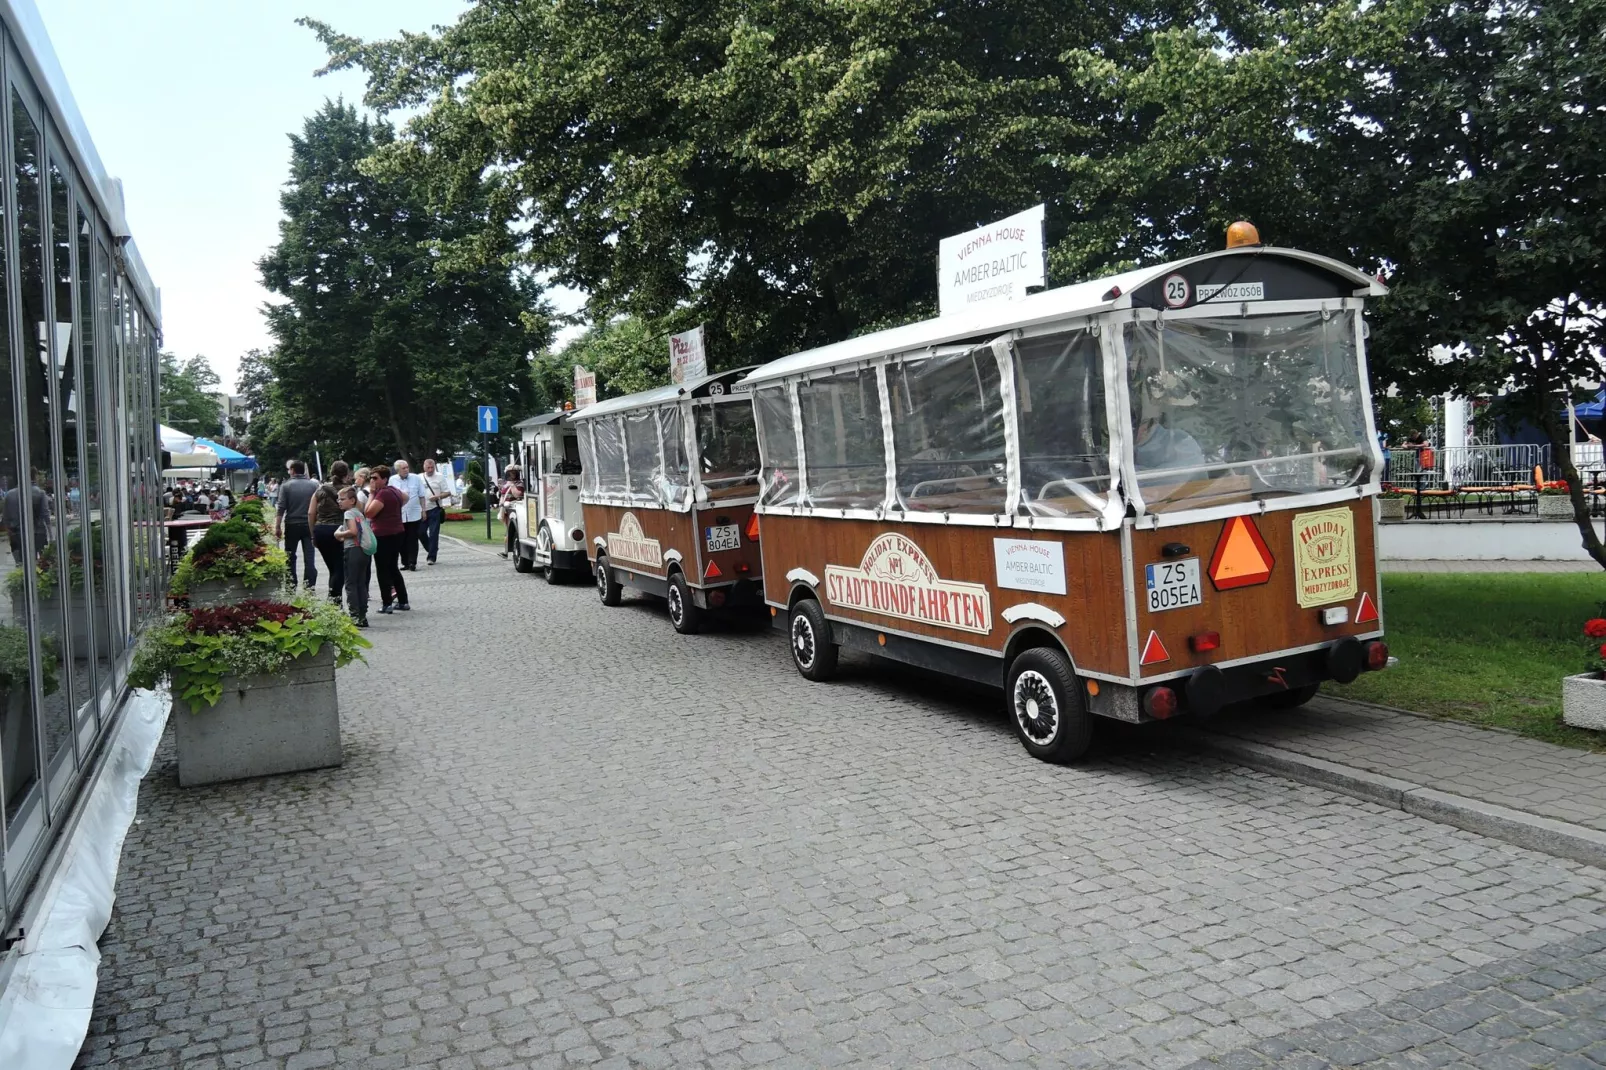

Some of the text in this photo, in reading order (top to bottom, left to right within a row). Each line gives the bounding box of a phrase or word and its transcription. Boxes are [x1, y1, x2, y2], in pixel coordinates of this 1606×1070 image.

[958, 228, 1026, 260] VIENNA HOUSE
[954, 251, 1027, 287] AMBER BALTIC
[1168, 282, 1186, 299] 25
[1240, 285, 1262, 297] OSÓB
[710, 384, 723, 395] 25
[715, 527, 731, 538] ZS
[1300, 522, 1347, 545] HOLIDAY
[709, 538, 739, 550] 804EA
[1006, 544, 1050, 558] VIENNA HOUSE
[863, 537, 935, 585] HOLIDAY EXPRESS
[1005, 561, 1054, 575] AMBER BALTIC
[1162, 563, 1186, 585] ZS
[1304, 563, 1349, 582] EXPRESS
[828, 573, 985, 629] STADTRUNDFAHRTEN
[1151, 584, 1199, 609] 805EA
